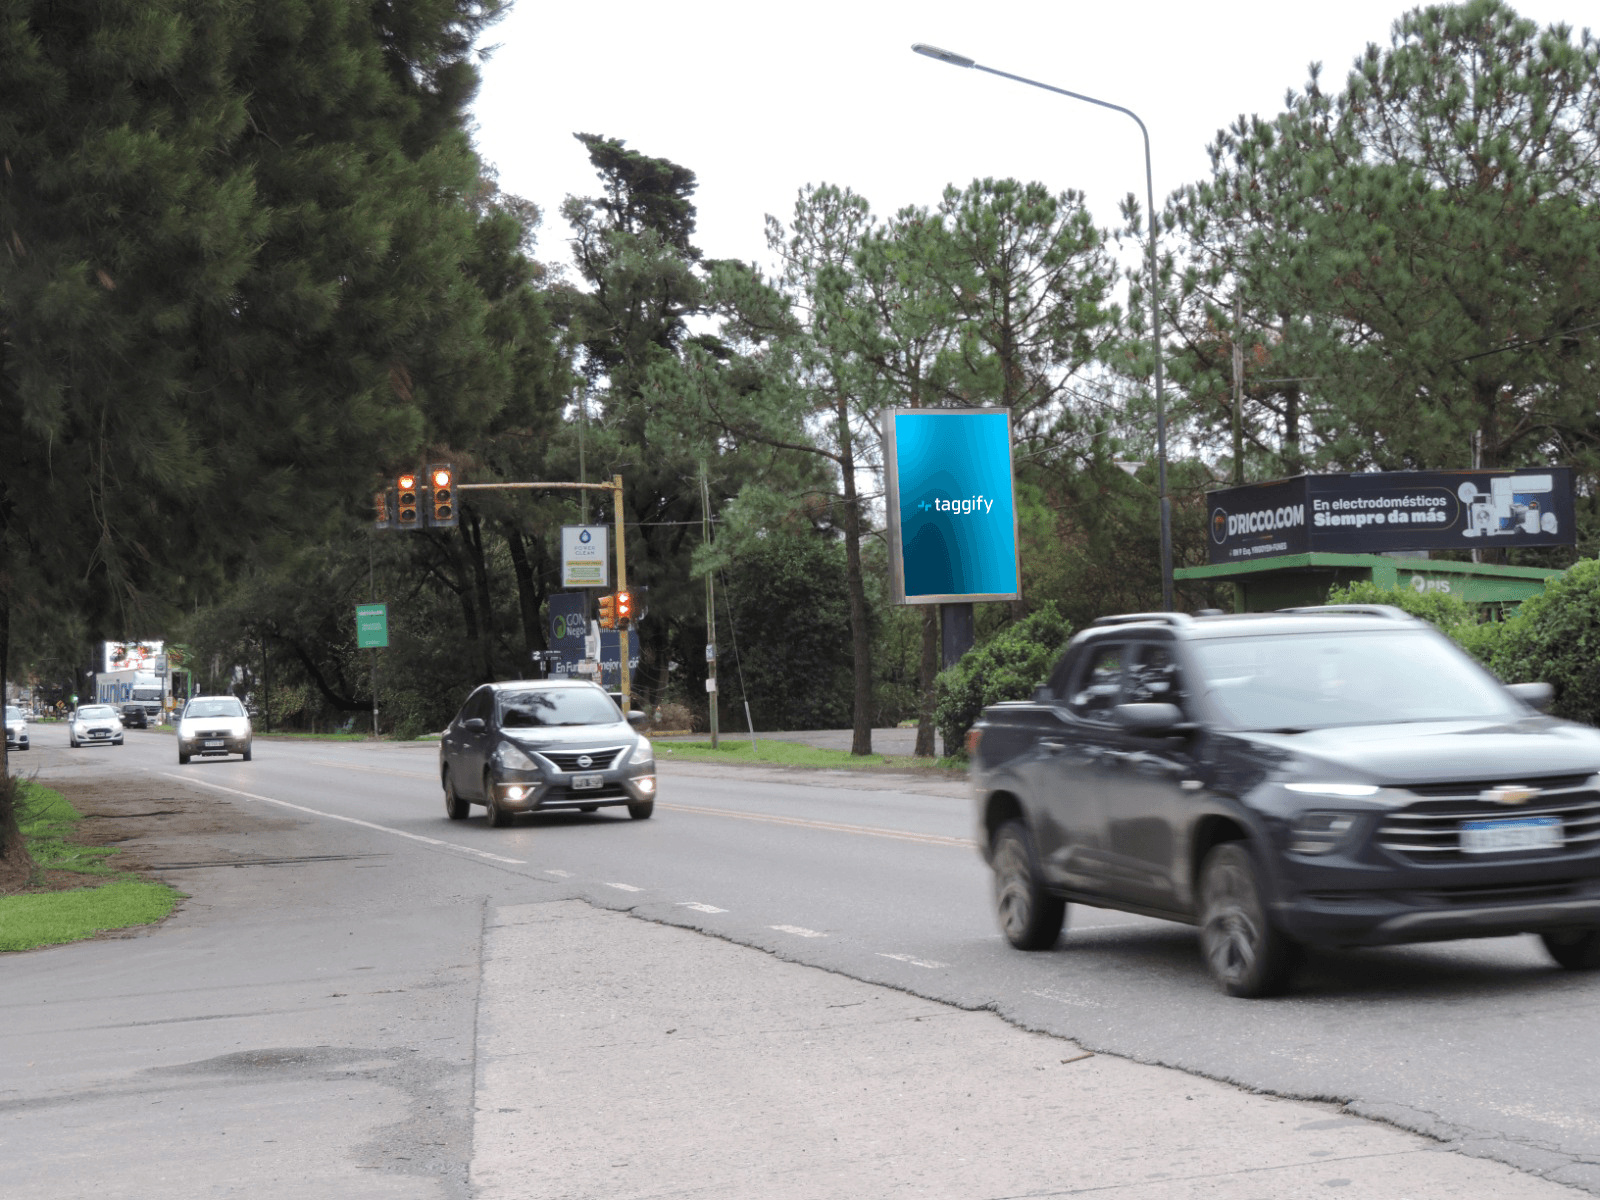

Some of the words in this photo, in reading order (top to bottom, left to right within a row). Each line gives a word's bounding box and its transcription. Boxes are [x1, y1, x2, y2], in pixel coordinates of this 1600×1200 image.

[935, 495, 994, 515] taggify
[1313, 499, 1330, 511] En
[1331, 495, 1447, 511] electrodomésticos
[1313, 511, 1386, 528] Siempre
[1387, 509, 1409, 523] da
[1410, 507, 1447, 523] más
